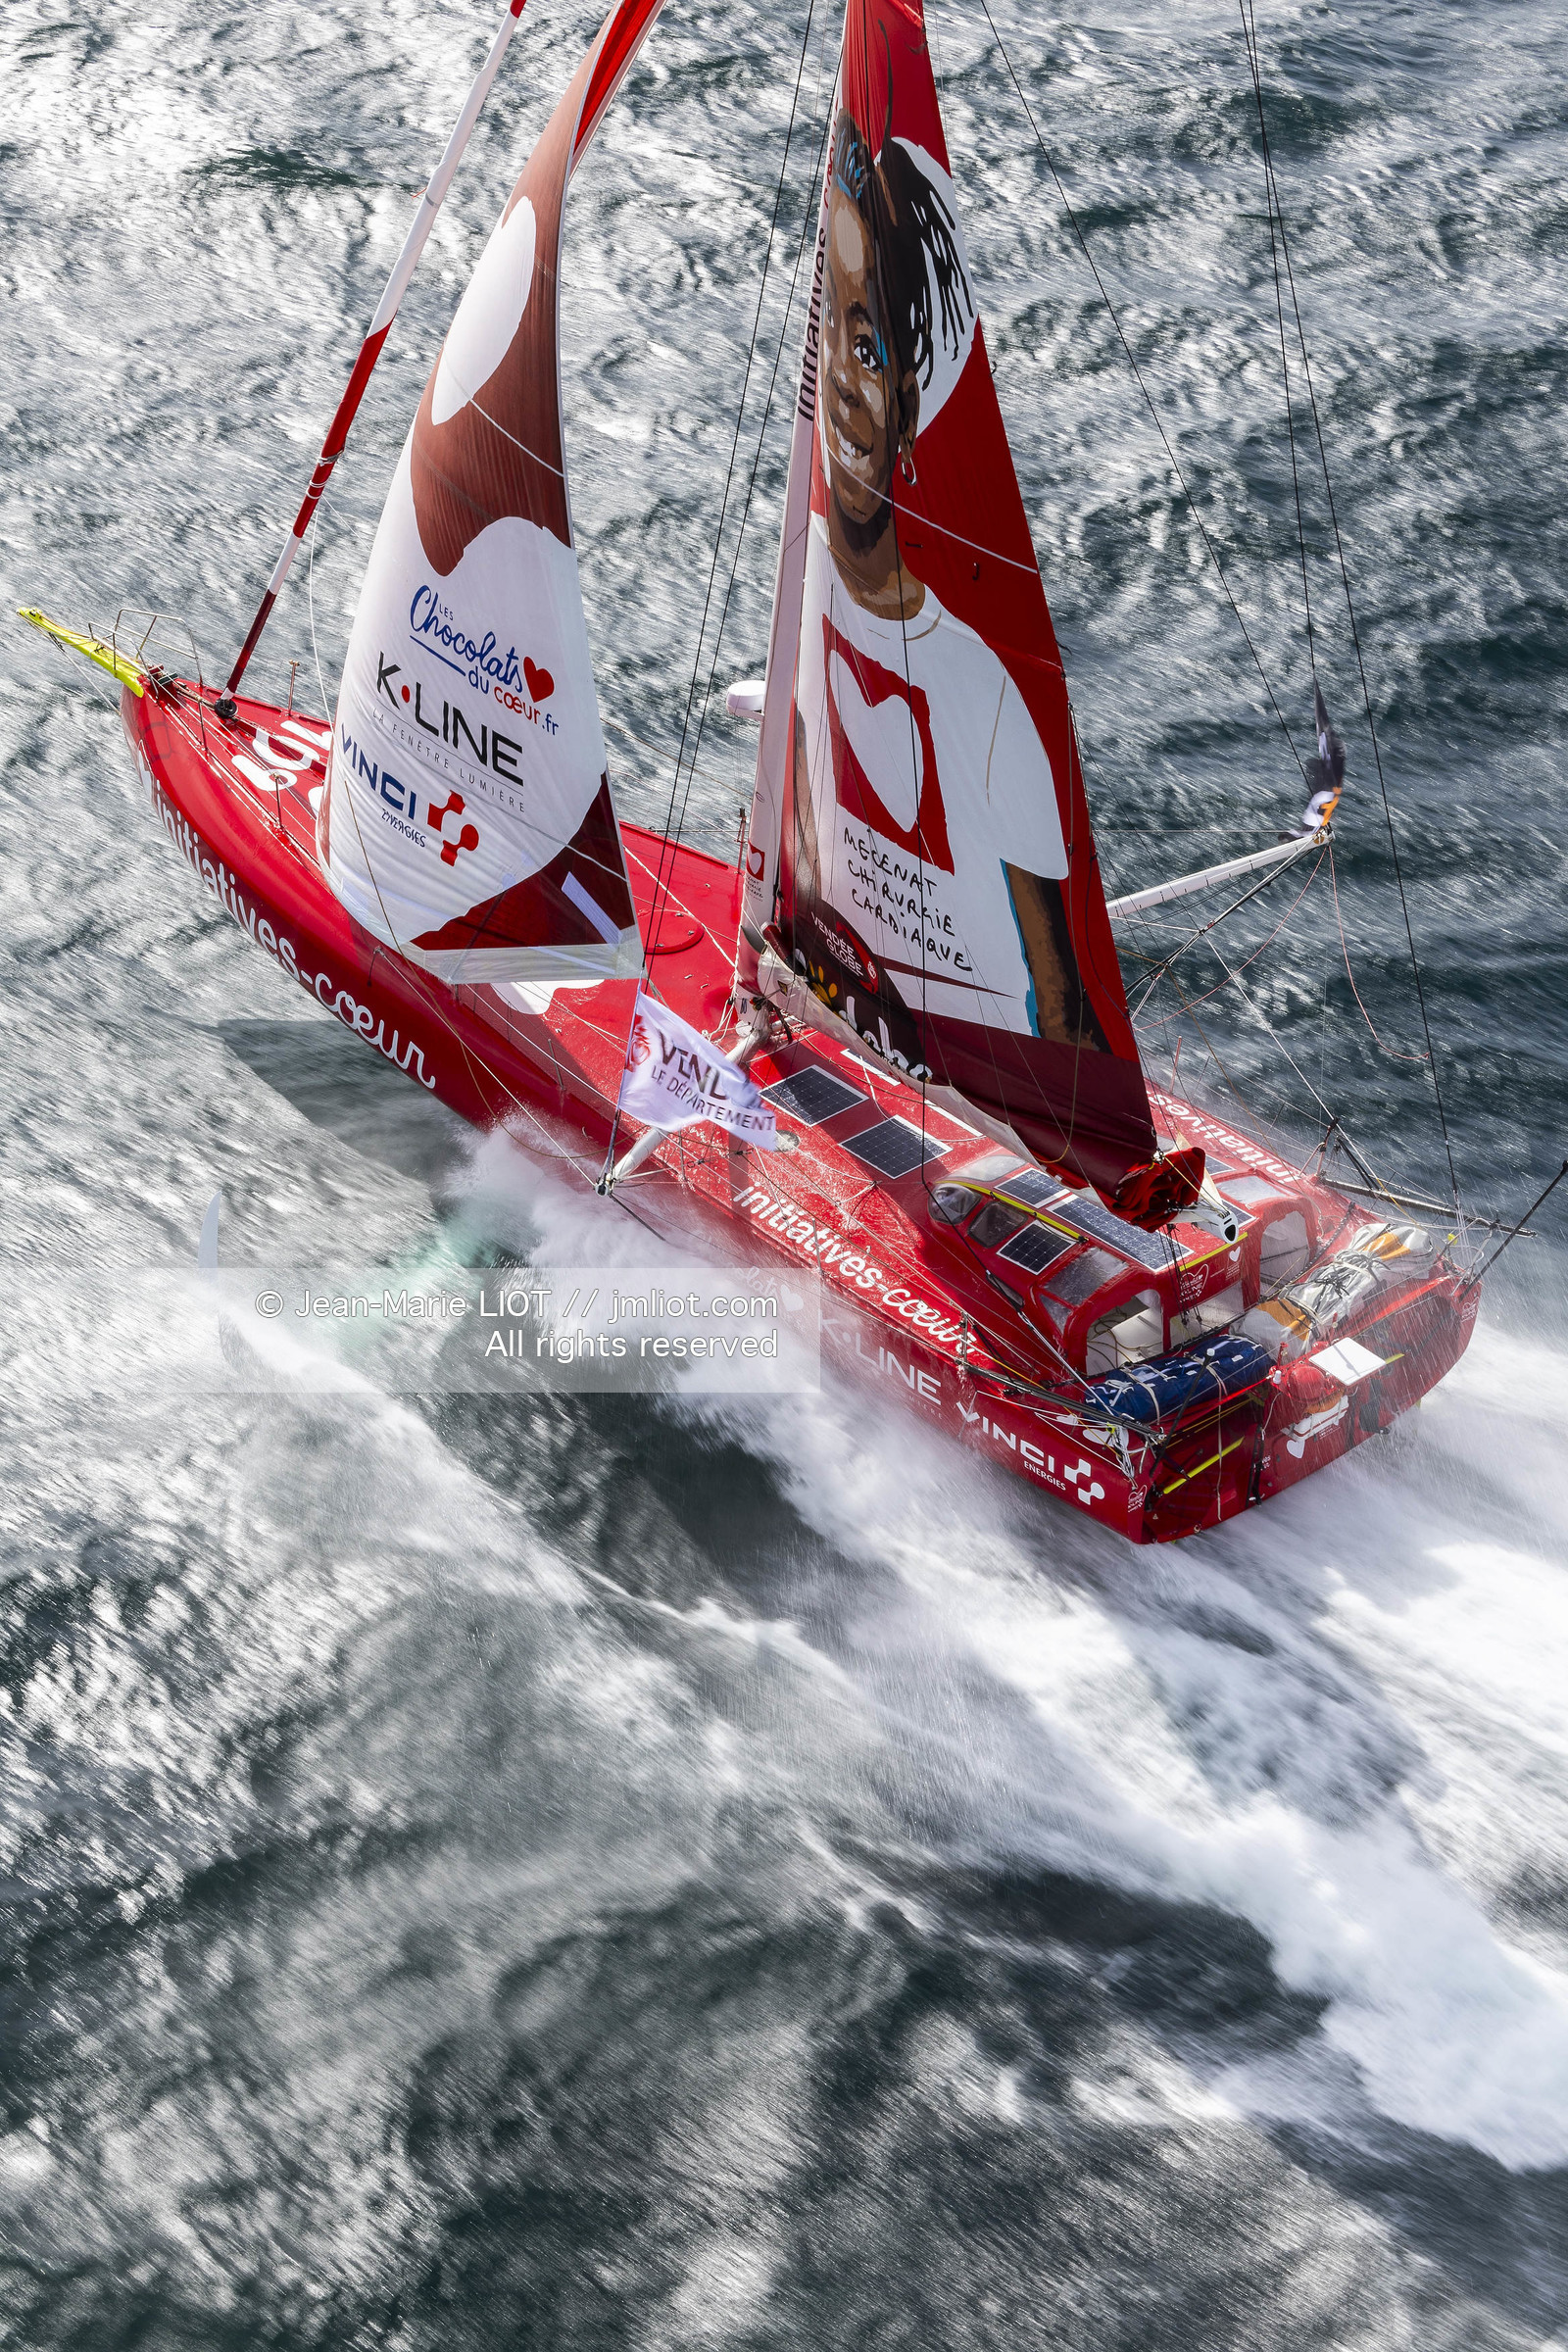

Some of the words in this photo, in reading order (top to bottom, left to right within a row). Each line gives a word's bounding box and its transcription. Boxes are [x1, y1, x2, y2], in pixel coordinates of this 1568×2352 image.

[410, 584, 523, 694] Chocolats
[438, 603, 454, 621] LES
[467, 665, 490, 695] du
[341, 722, 416, 821] VINCI
[372, 709, 385, 723] LA
[460, 767, 526, 813] LUMIÈRE
[810, 911, 857, 959] VENDÉE
[826, 938, 864, 976] GLOBE
[651, 1064, 663, 1086] LE
[666, 1074, 775, 1132] DÉPARTEMENT
[956, 1400, 1055, 1473] VINCI
[1024, 1460, 1066, 1492] ENERGIES
